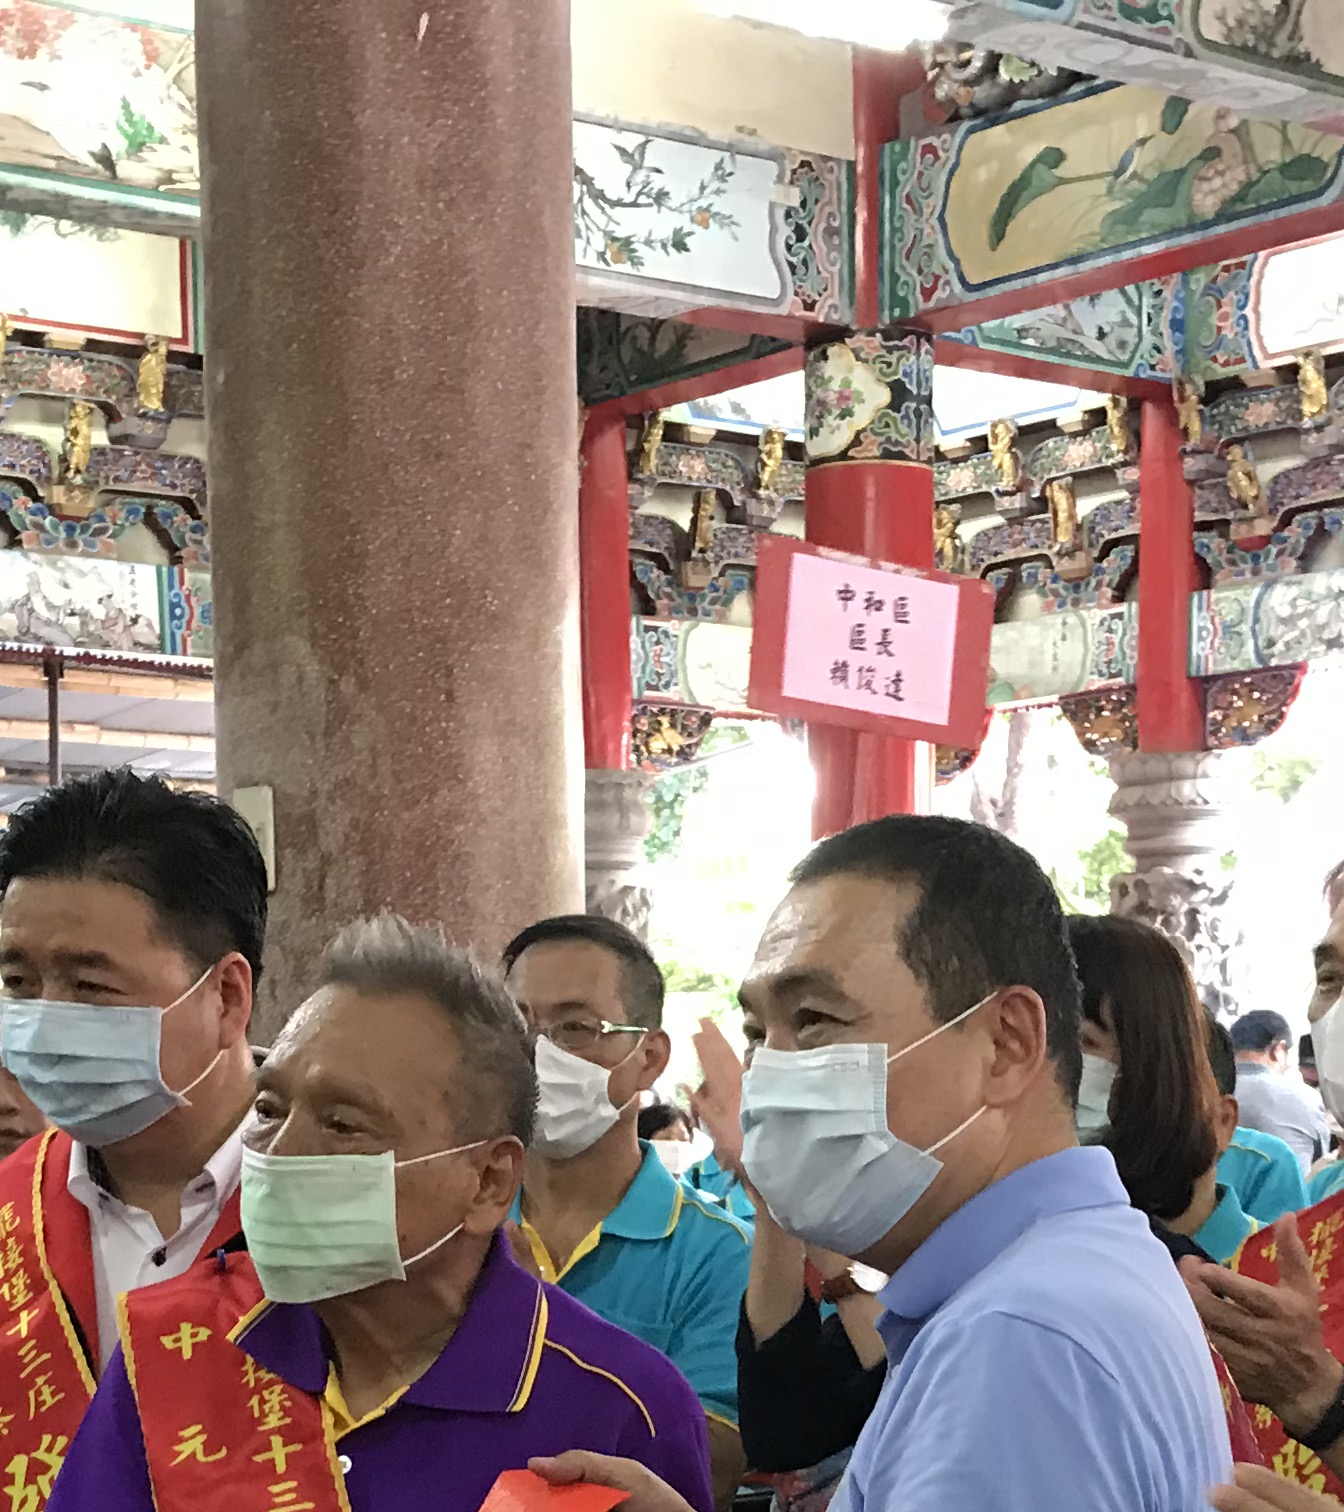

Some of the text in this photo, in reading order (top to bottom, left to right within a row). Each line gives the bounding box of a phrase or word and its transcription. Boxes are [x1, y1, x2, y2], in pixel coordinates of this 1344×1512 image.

[835, 582, 911, 624] 中和區
[849, 622, 896, 657] 區長
